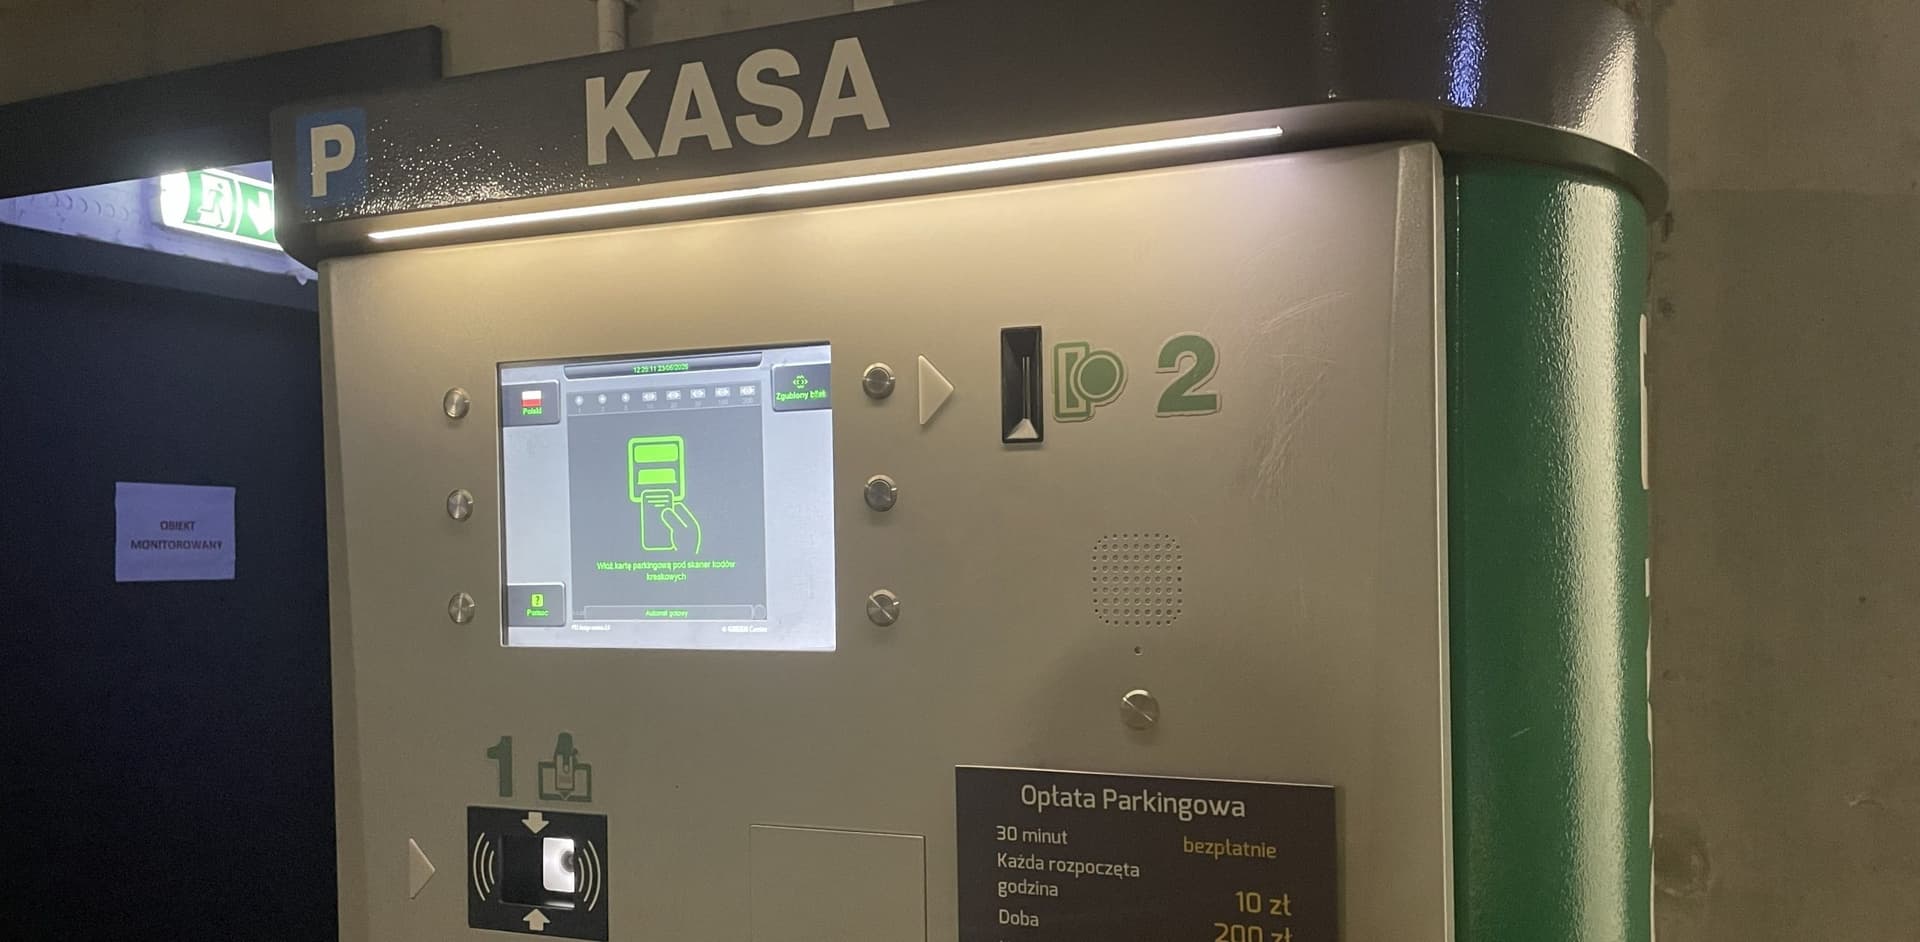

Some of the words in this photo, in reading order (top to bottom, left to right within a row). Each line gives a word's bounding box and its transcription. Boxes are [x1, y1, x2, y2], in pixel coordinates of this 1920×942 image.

[585, 36, 890, 167] KASA
[309, 124, 356, 197] P
[1156, 332, 1219, 415] 2
[776, 391, 809, 401] Zgubiony
[160, 520, 196, 531] OBIEKT
[130, 540, 223, 551] MONITOROWANY
[614, 560, 631, 571] kartę
[672, 560, 686, 571] pod
[712, 560, 736, 569] kodów
[526, 608, 550, 617] Pomoc
[486, 735, 513, 798] 1
[1020, 783, 1096, 813] Opłata
[1102, 787, 1247, 822] Parkingowa
[996, 825, 1018, 842] 30
[1022, 828, 1068, 846] minut
[1182, 835, 1278, 860] bezpłatnie
[997, 852, 1045, 872] Każda
[1048, 858, 1141, 880] rozpoczęta
[997, 879, 1059, 898] godzina
[1235, 890, 1262, 914] 10
[1269, 893, 1293, 917] zł
[999, 908, 1040, 928] Doba
[1213, 922, 1263, 942] 200
[1270, 927, 1293, 942] zł
